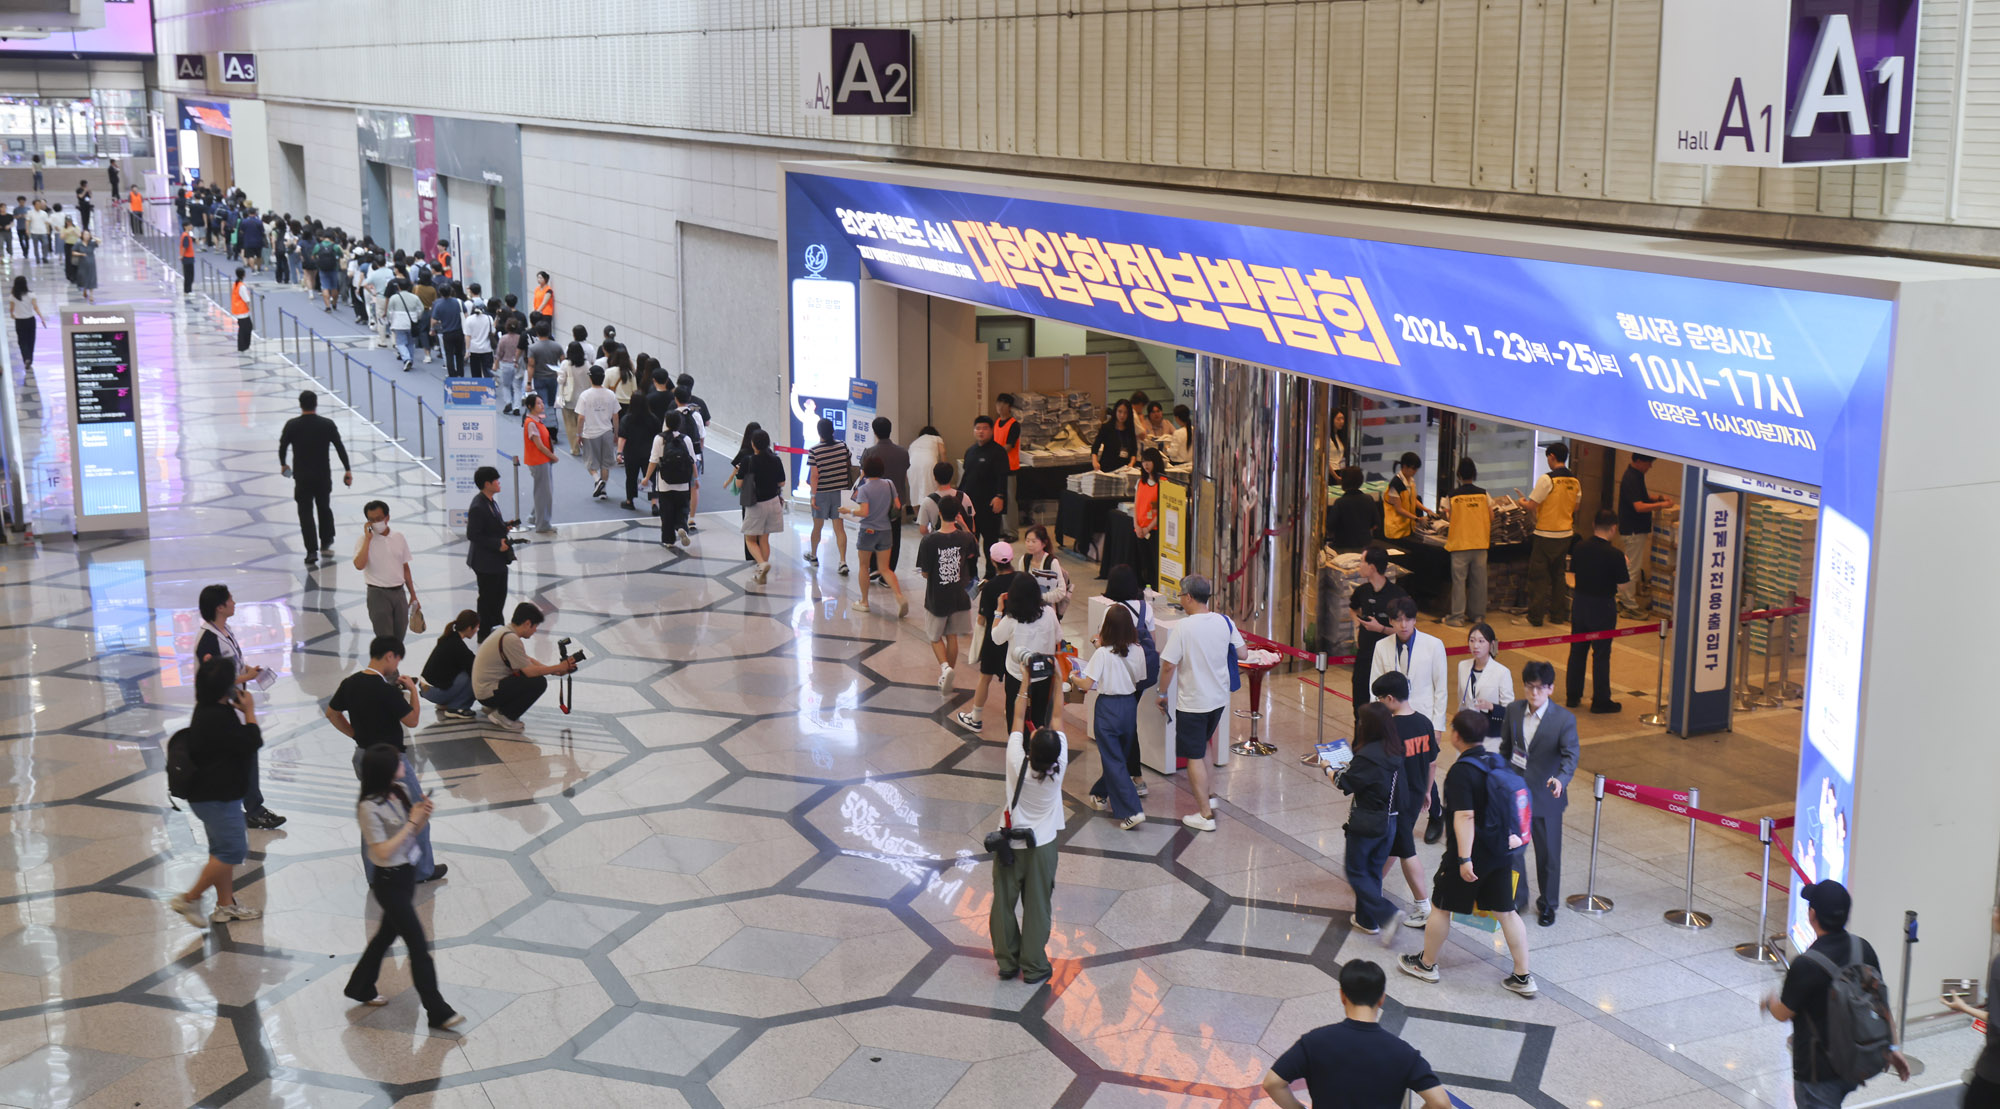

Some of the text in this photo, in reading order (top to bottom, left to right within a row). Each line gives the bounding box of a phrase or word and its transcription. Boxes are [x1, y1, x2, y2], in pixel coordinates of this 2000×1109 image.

[179, 58, 204, 77] A4
[225, 56, 255, 79] A3
[836, 42, 908, 103] A2
[1789, 14, 1905, 138] A1
[1677, 77, 1773, 153] Hall A1
[951, 219, 1401, 367] 대학입학정보박람회
[1394, 313, 1467, 351] 2026.
[1464, 324, 1495, 357] 7.
[1616, 312, 1776, 361] 행사장 운영시간
[1629, 352, 1805, 418] 10시-17시
[458, 432, 483, 441] 대기줄
[462, 421, 479, 431] 입장
[1648, 400, 1817, 452] (입장은 16시30분까지)
